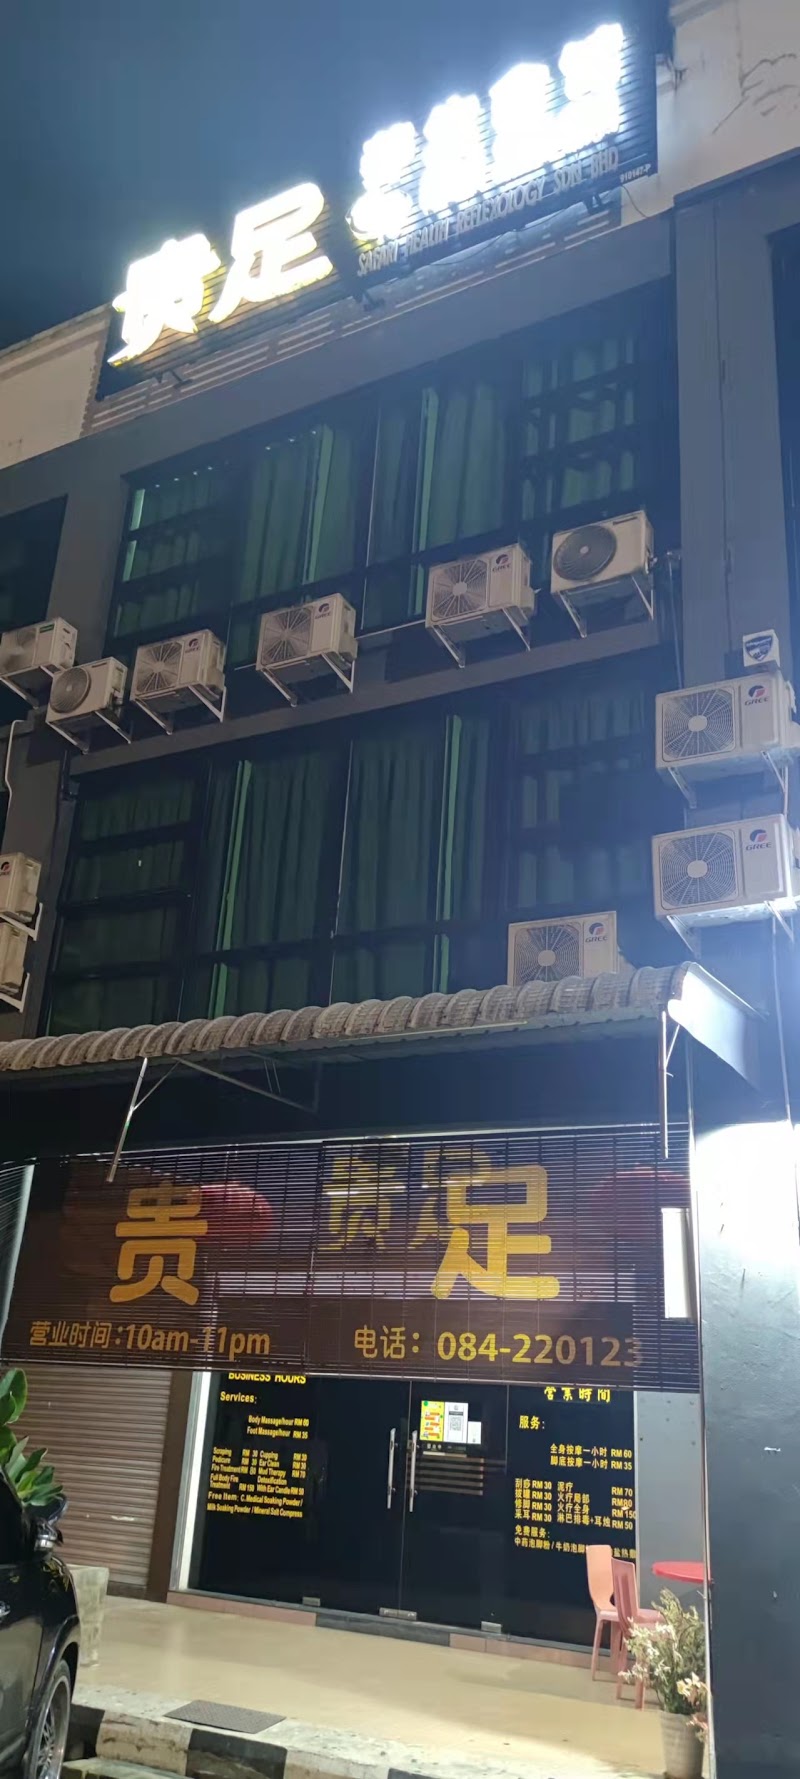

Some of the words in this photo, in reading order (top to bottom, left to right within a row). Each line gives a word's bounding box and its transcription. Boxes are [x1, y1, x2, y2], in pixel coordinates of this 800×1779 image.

[405, 218, 450, 253] HEALTH
[456, 179, 547, 235] REFLEXOLOGY
[553, 160, 583, 194] SDN
[590, 146, 620, 179] BHD
[107, 181, 333, 366] 贵足
[745, 842, 772, 851] GREE
[585, 935, 608, 943] GREE
[437, 1331, 643, 1367] 084-220123
[220, 1391, 257, 1404] Services:
[248, 1414, 261, 1425] Body
[294, 1418, 302, 1426] RM
[247, 1426, 258, 1435] Foot
[292, 1430, 301, 1439] RM
[302, 1431, 309, 1439] 35
[242, 1448, 250, 1456] RM
[293, 1452, 301, 1460] RM
[550, 1443, 607, 1458] 全身按摩一小时
[611, 1449, 622, 1458] RM
[623, 1449, 632, 1459] 60
[241, 1457, 249, 1465] RM
[293, 1461, 300, 1469] RM
[550, 1456, 608, 1470] 脚底按摩一小时
[611, 1460, 622, 1470] RM
[623, 1461, 632, 1470] 35
[218, 1473, 230, 1483] Body
[292, 1470, 300, 1478] RM
[239, 1483, 247, 1491] RM
[267, 1485, 275, 1493] Ear
[532, 1480, 543, 1489] RM
[544, 1481, 552, 1490] 30
[208, 1491, 222, 1500] Free
[532, 1491, 543, 1500] RM
[544, 1492, 552, 1501] 30
[611, 1486, 623, 1496] RM
[624, 1488, 633, 1497] 70
[532, 1502, 543, 1511] RM
[544, 1503, 552, 1511] 30
[557, 1503, 590, 1515] 火疗全身
[612, 1509, 623, 1518] RM
[625, 1510, 637, 1519] 150
[532, 1512, 543, 1522] RM
[544, 1513, 552, 1523] 30
[612, 1520, 623, 1529] RM
[624, 1521, 633, 1530] 50
[555, 1542, 587, 1554] 牛奶泡脚
